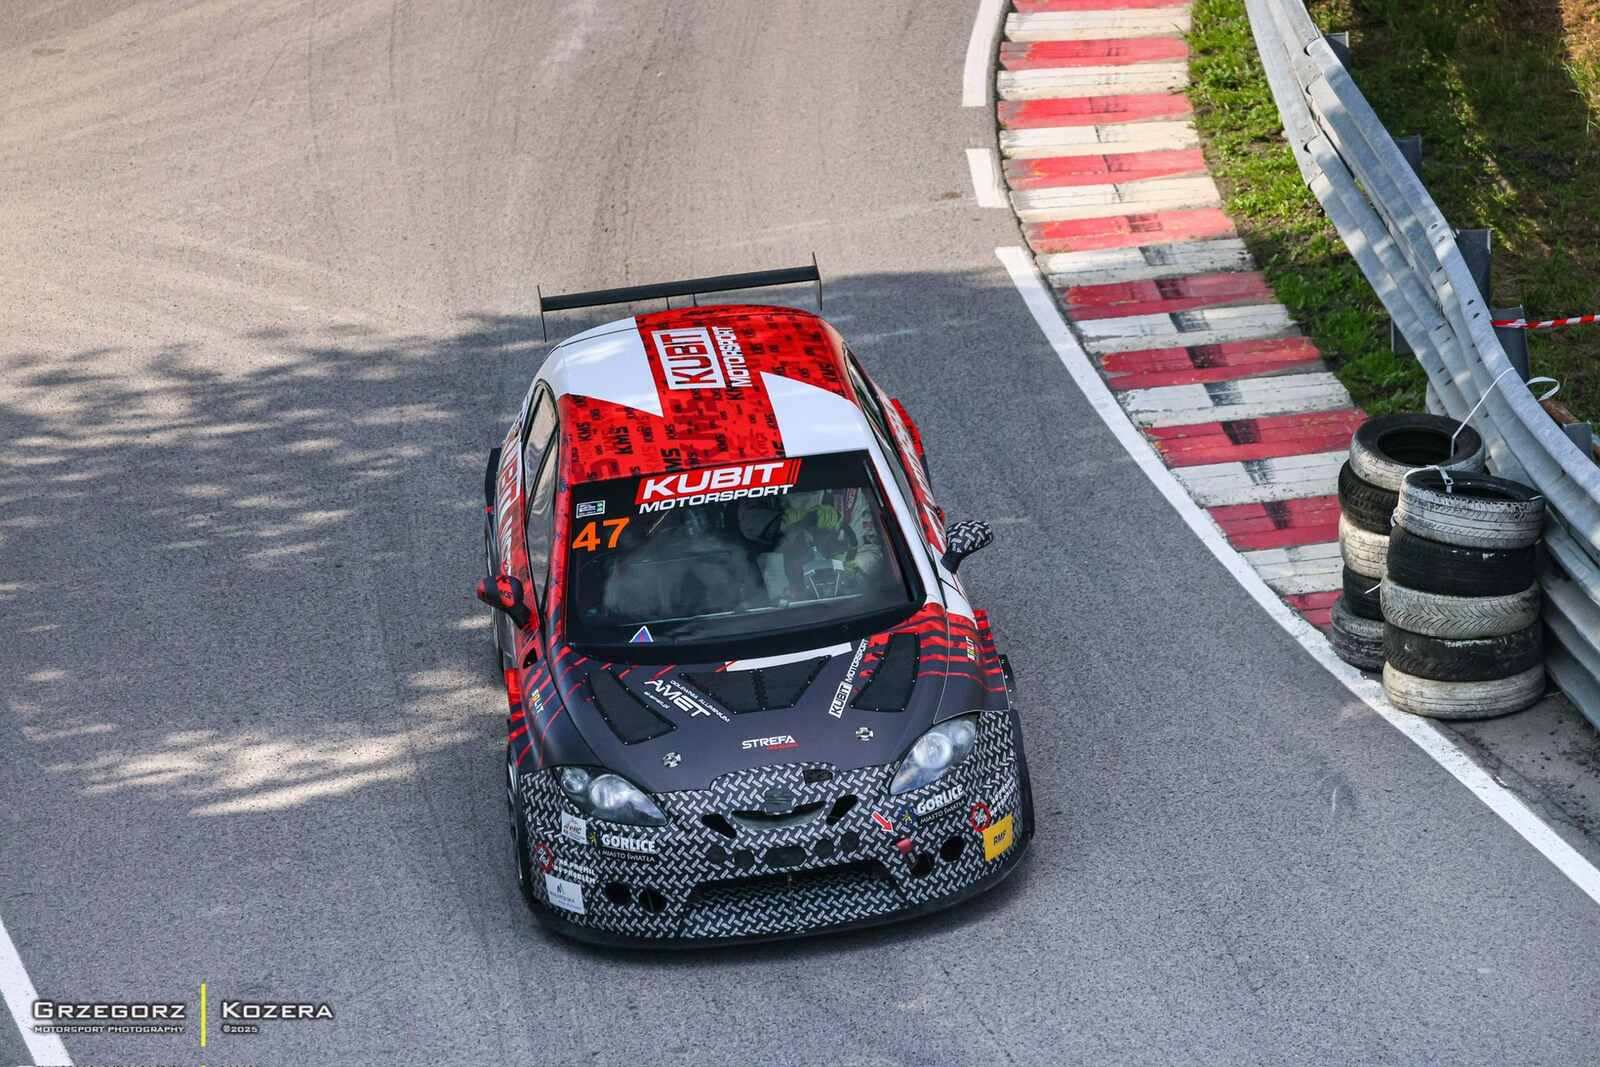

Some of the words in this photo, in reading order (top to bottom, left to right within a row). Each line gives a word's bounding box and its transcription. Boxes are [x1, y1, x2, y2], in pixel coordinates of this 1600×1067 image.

[660, 333, 718, 386] KUBIT
[712, 327, 752, 387] MOTORSPORT
[614, 426, 633, 455] KMS
[641, 462, 786, 499] KUBIT
[638, 484, 794, 514] MOTORSPORT
[571, 517, 630, 552] 47
[845, 638, 869, 684] MOTORSPORT
[830, 682, 852, 716] KUBIT
[742, 735, 796, 749] STREFA
[917, 784, 964, 815] GORLICE
[601, 833, 656, 852] GORLICE
